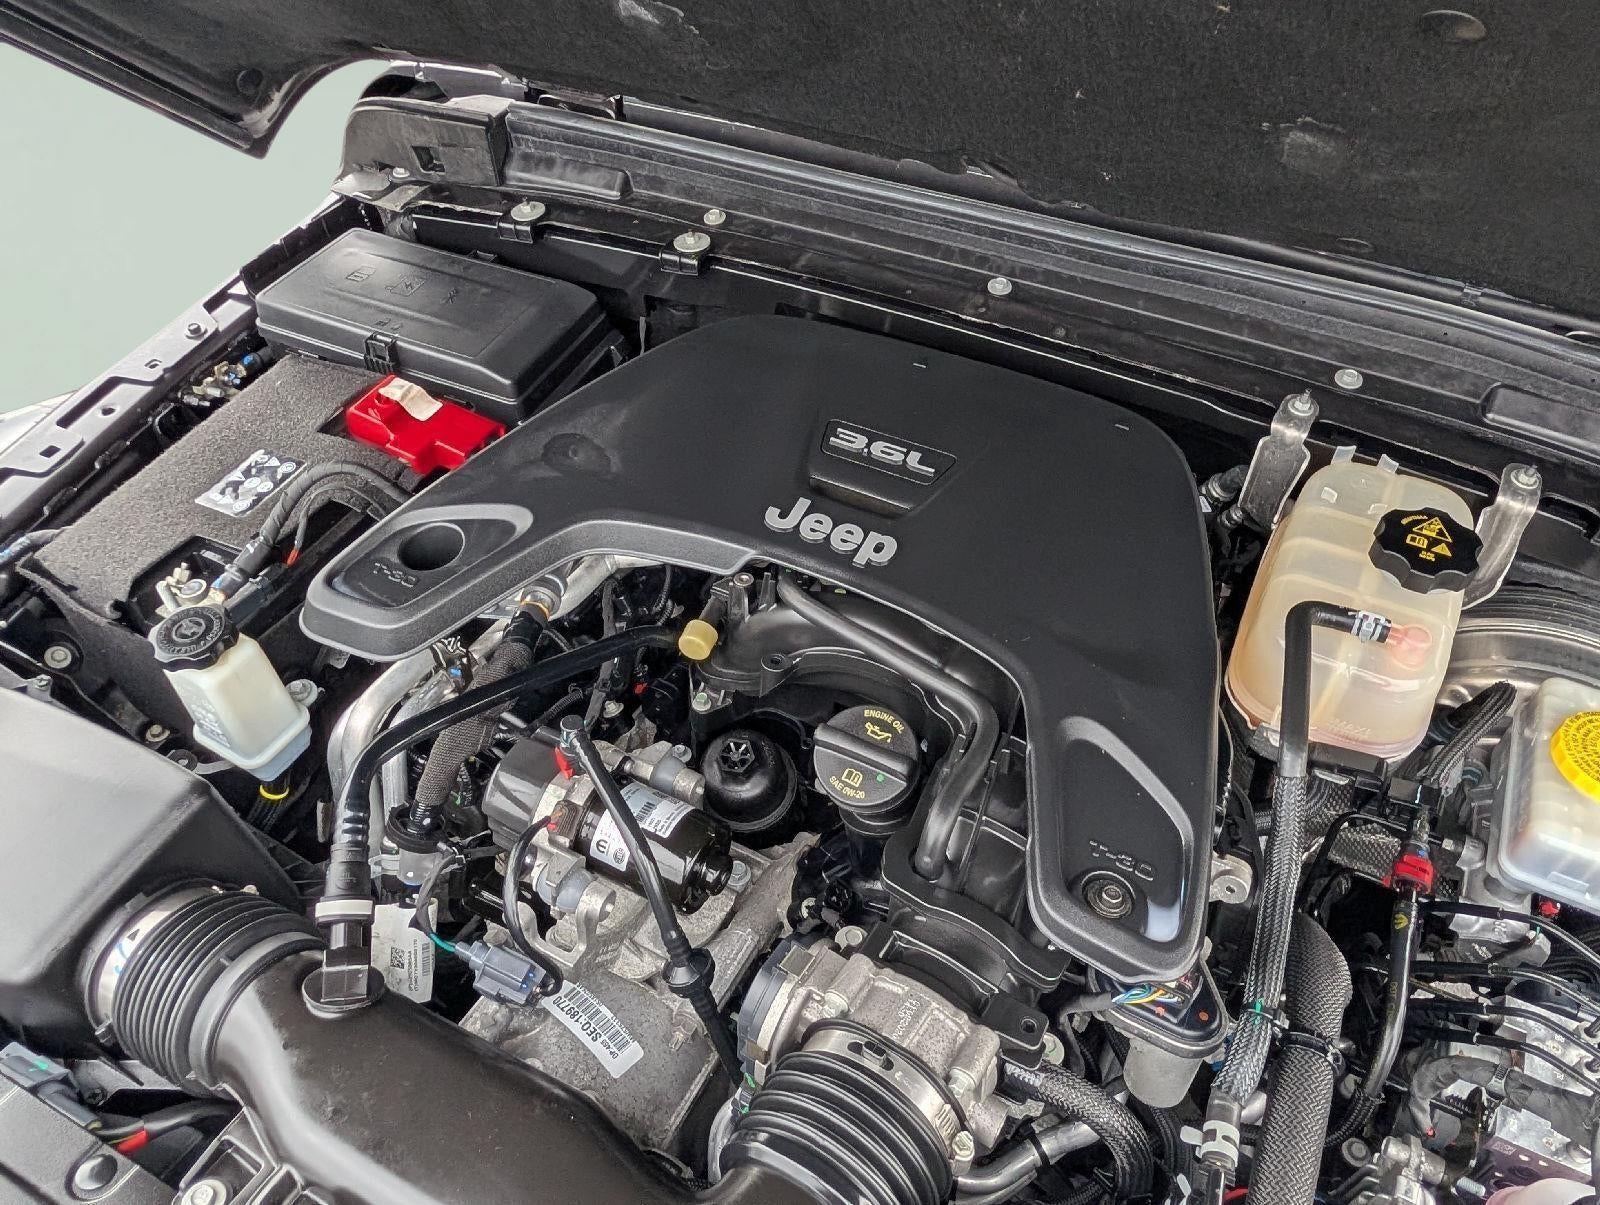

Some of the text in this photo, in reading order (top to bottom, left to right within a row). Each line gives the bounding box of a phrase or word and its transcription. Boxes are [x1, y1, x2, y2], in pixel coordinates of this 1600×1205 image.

[829, 428, 936, 477] 3.6L
[763, 496, 898, 568] Jeep
[864, 708, 906, 734] ENGINE OIL
[829, 776, 866, 800] SAE 0W-20
[553, 996, 602, 1042] SEQ:189770
